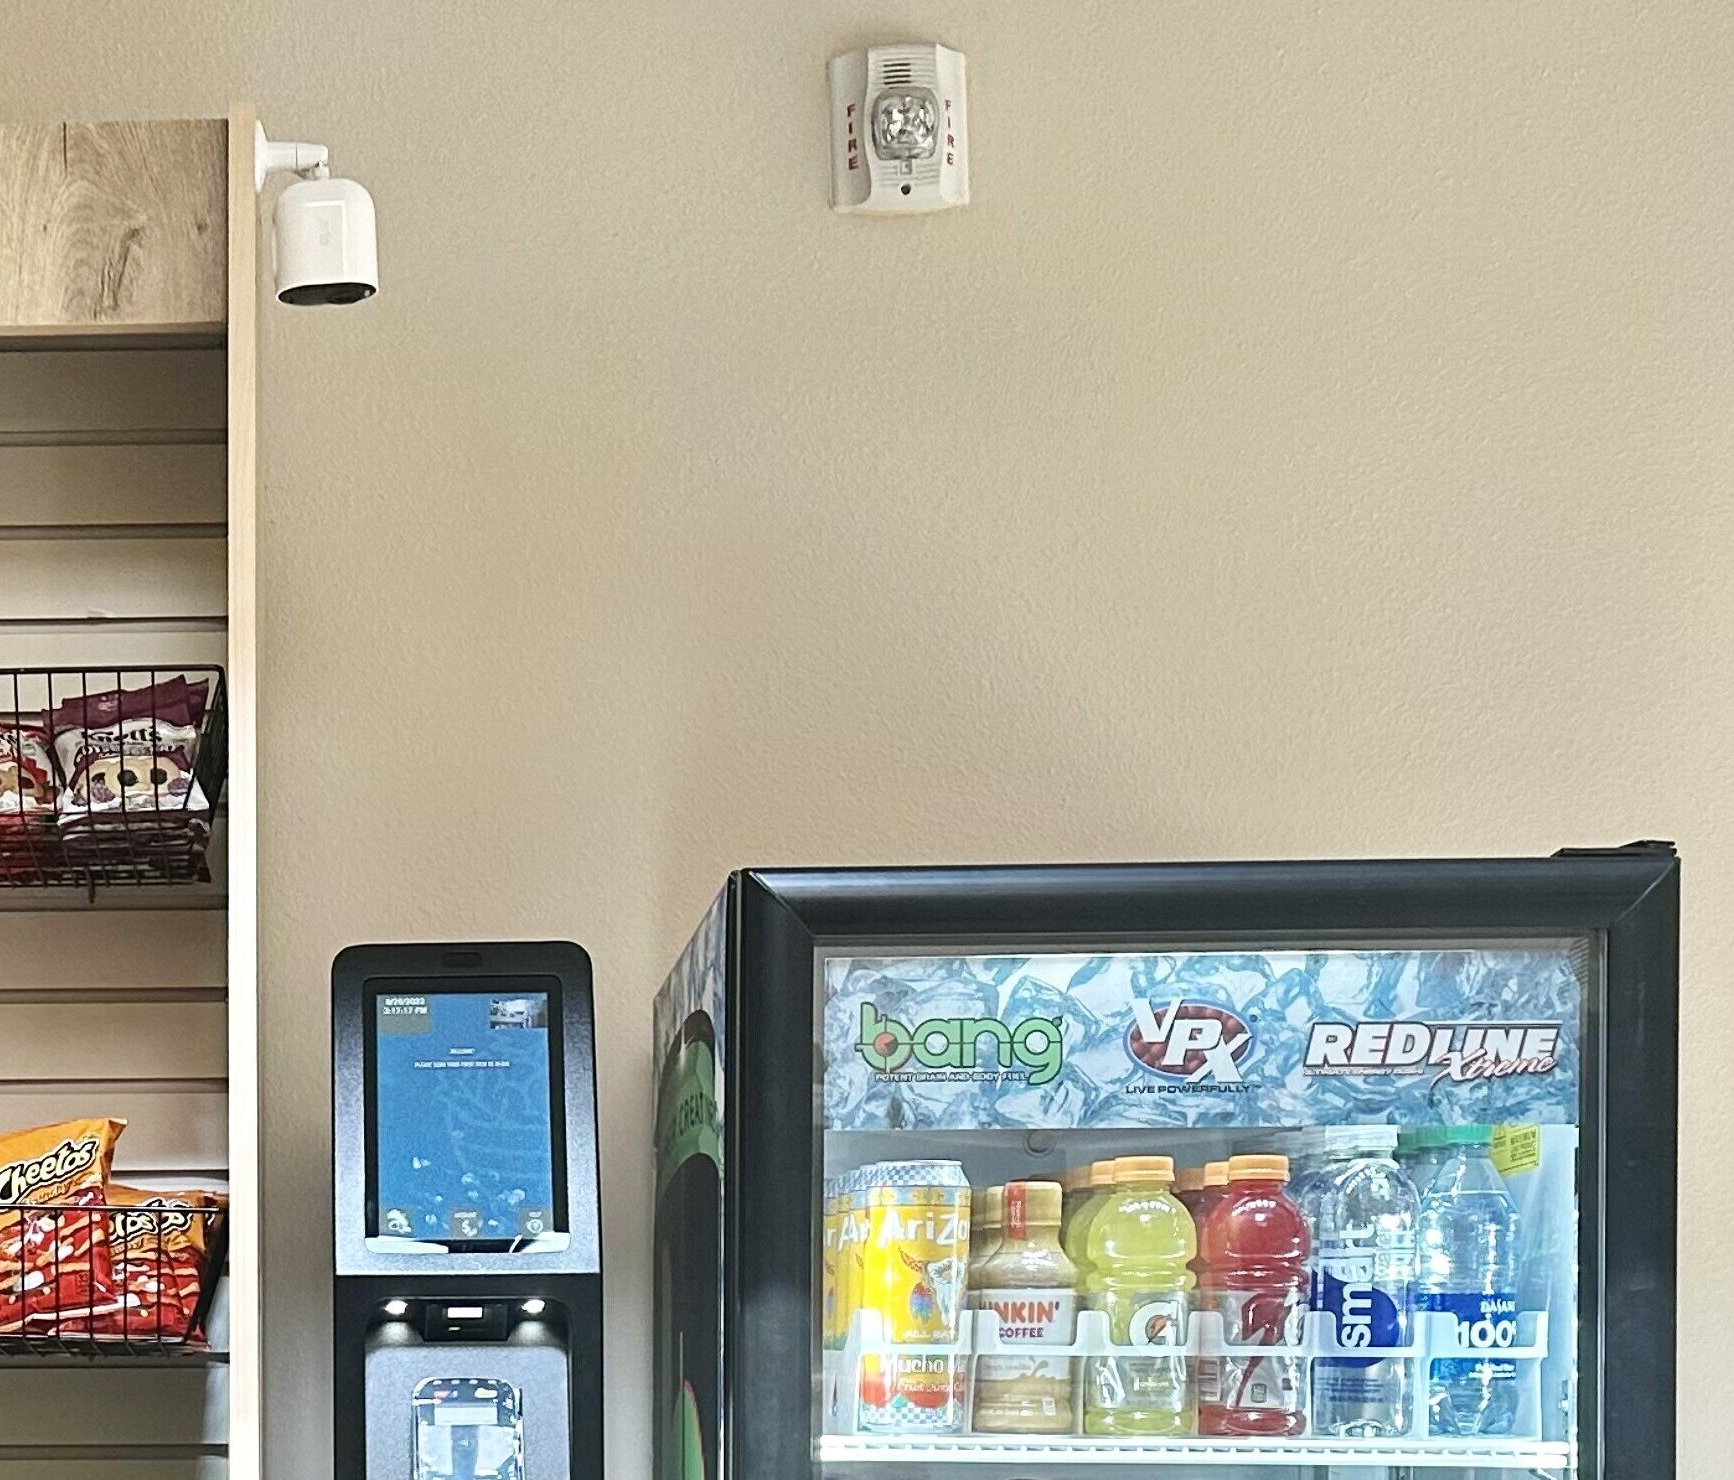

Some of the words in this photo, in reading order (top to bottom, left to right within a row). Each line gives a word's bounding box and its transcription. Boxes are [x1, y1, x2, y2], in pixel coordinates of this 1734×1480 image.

[846, 103, 859, 170] FIRE
[945, 99, 955, 166] FIRE
[855, 1001, 1063, 1085] bang
[1128, 997, 1253, 1084] VPX
[1304, 1021, 1560, 1067] REDLINE
[1125, 1085, 1155, 1094] LIVE
[1158, 1084, 1250, 1094] POWERFULLY
[1431, 1048, 1559, 1098] Xtreme
[994, 1300, 1060, 1324] NKIN'
[998, 1327, 1044, 1338] COFFEE
